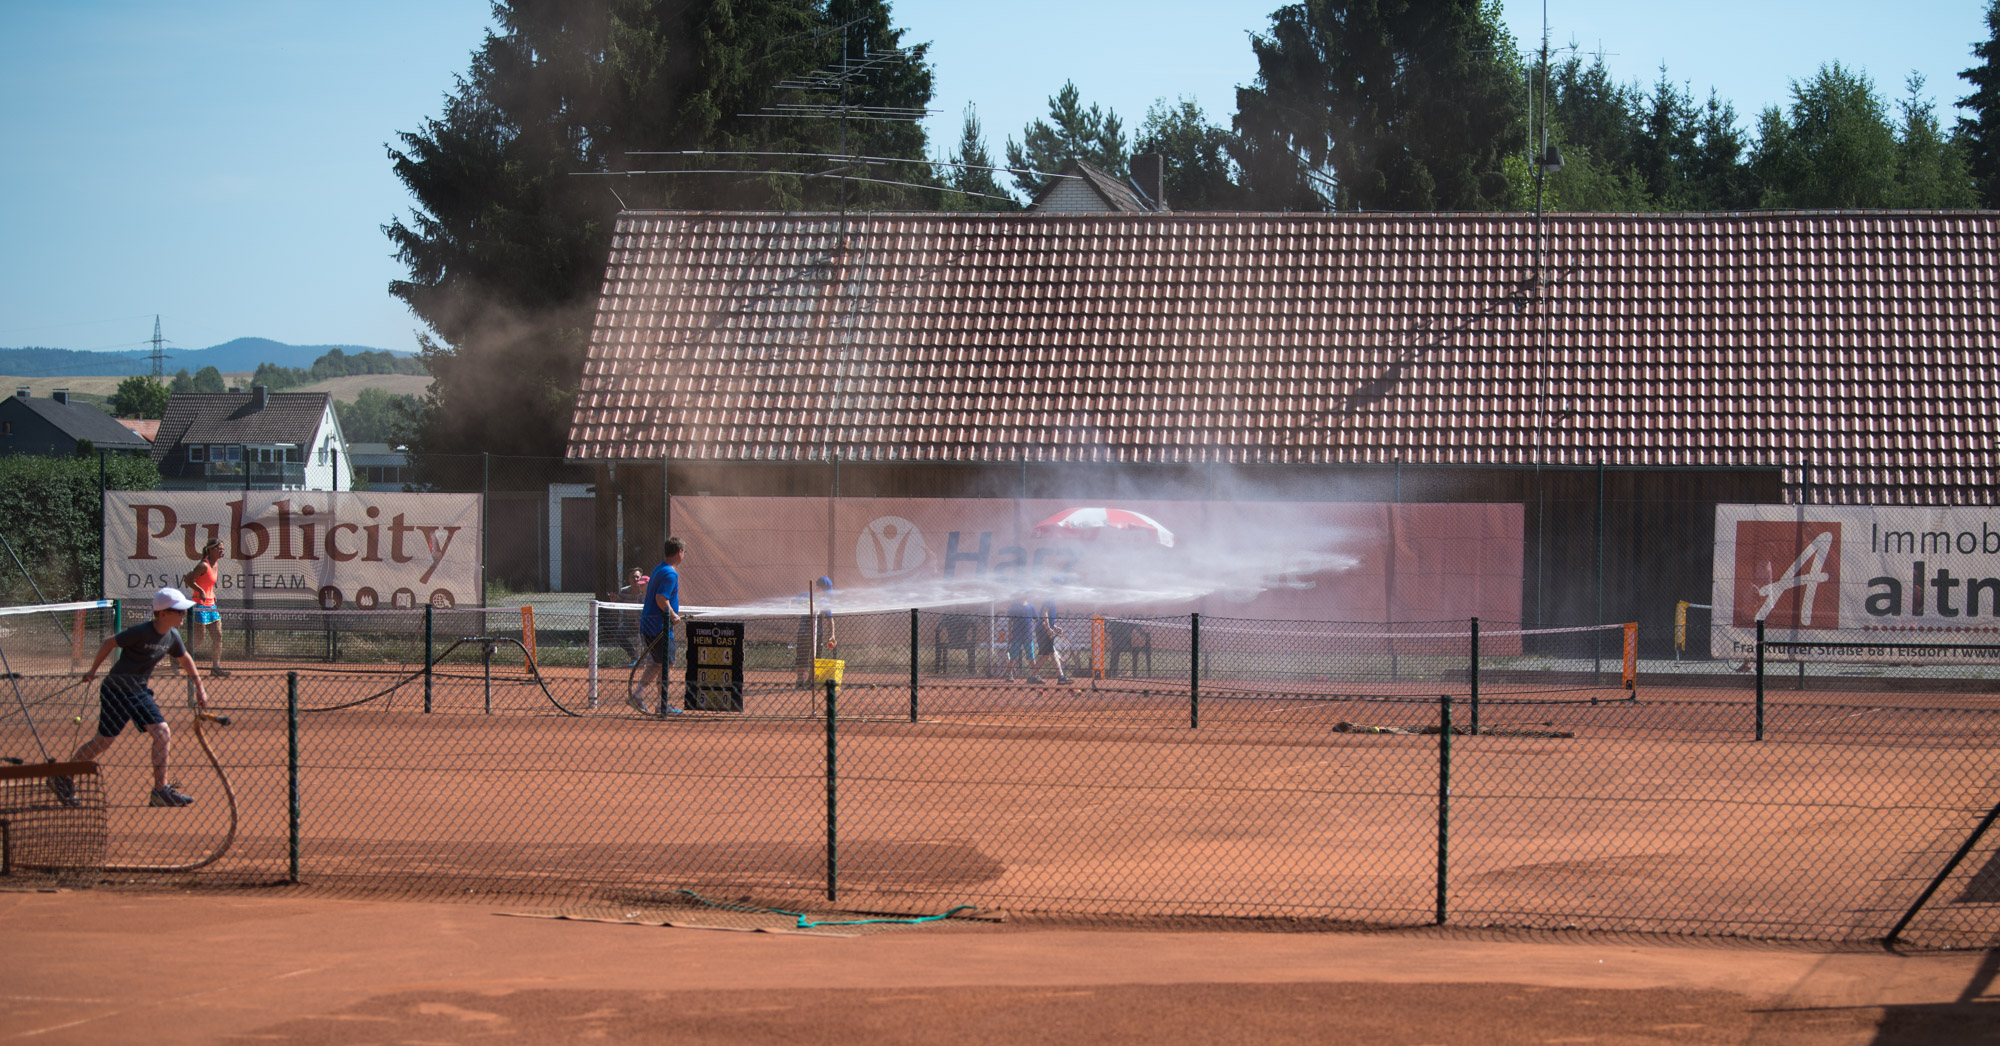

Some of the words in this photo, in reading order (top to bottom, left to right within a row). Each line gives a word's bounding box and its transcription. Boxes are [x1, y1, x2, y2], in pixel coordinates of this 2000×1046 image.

[127, 498, 462, 585] Publicity
[127, 573, 168, 589] DAS
[693, 636, 713, 645] HEIM
[716, 637, 737, 646] GAST
[1733, 641, 1813, 655] Frakfurter
[1868, 644, 1884, 657] 68
